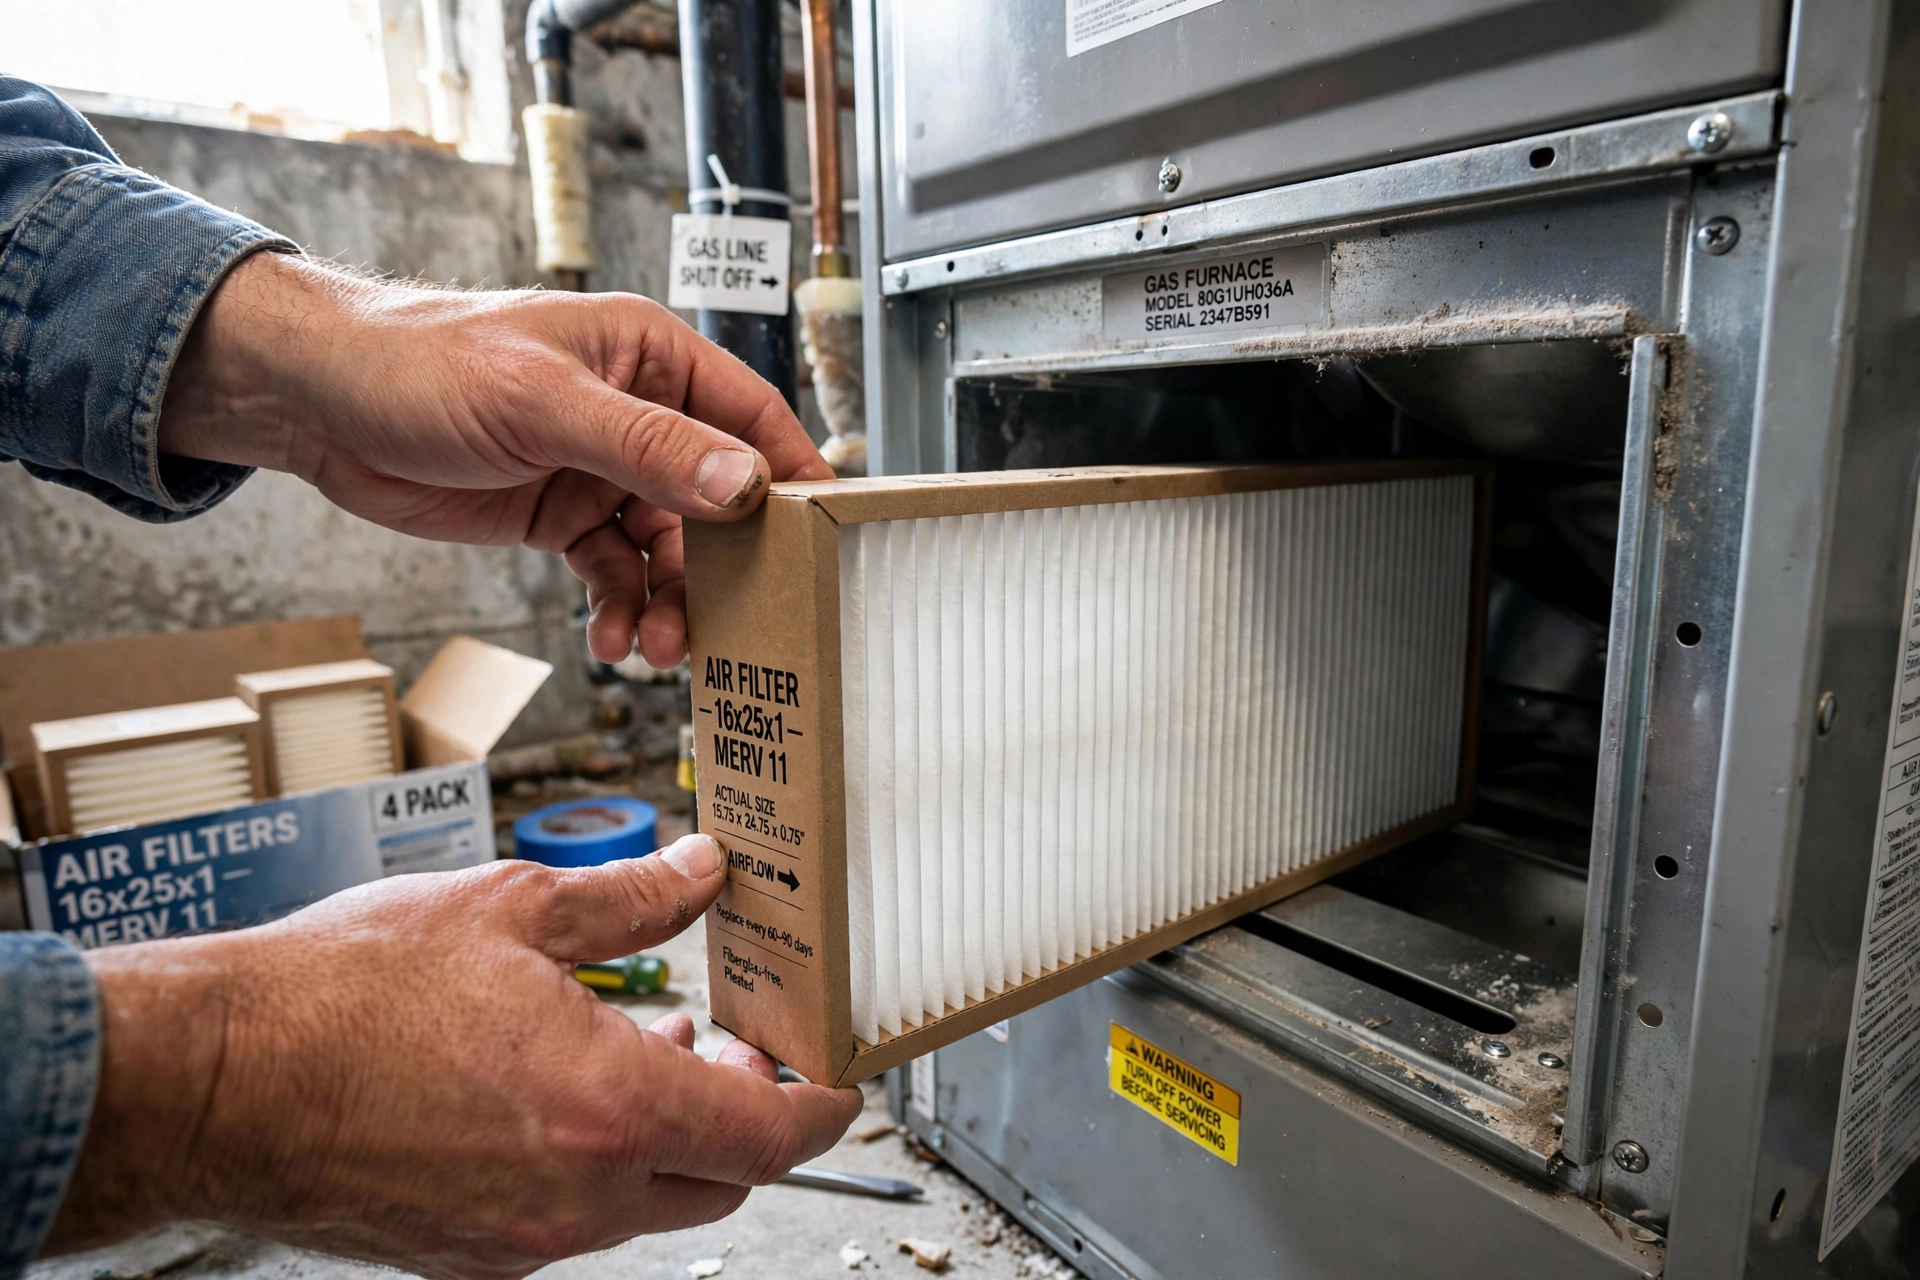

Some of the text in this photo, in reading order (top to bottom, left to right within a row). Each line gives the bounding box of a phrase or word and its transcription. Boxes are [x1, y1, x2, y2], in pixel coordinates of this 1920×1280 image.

[687, 237, 768, 263] GAS LINE
[681, 266, 755, 289] SHUT OFF
[1144, 257, 1274, 293] GAS FURNACE
[1145, 279, 1294, 313] MODEL 80G1UH036A
[1146, 303, 1270, 331] SERIAL 2347B591
[705, 656, 800, 708] AIR FILTER
[714, 734, 787, 785] MERV 11
[382, 778, 470, 820] 4 PACK
[715, 784, 776, 817] ACTUAL SIZE
[712, 803, 734, 823] 15.75
[736, 813, 742, 827] x
[745, 813, 770, 835] 24.75
[772, 825, 778, 839] x
[54, 812, 300, 889] AIR FILTERS
[728, 849, 774, 882] AIRFLOW
[62, 900, 217, 948] MERV 11
[716, 902, 744, 926] Replace
[746, 919, 766, 939] every
[795, 937, 813, 958] days
[724, 966, 754, 993] Pleated
[1141, 1044, 1214, 1101] WARNING
[1122, 1074, 1226, 1151] BEFORE SERVICING
[1125, 1058, 1221, 1130] TURN OFF POWER
